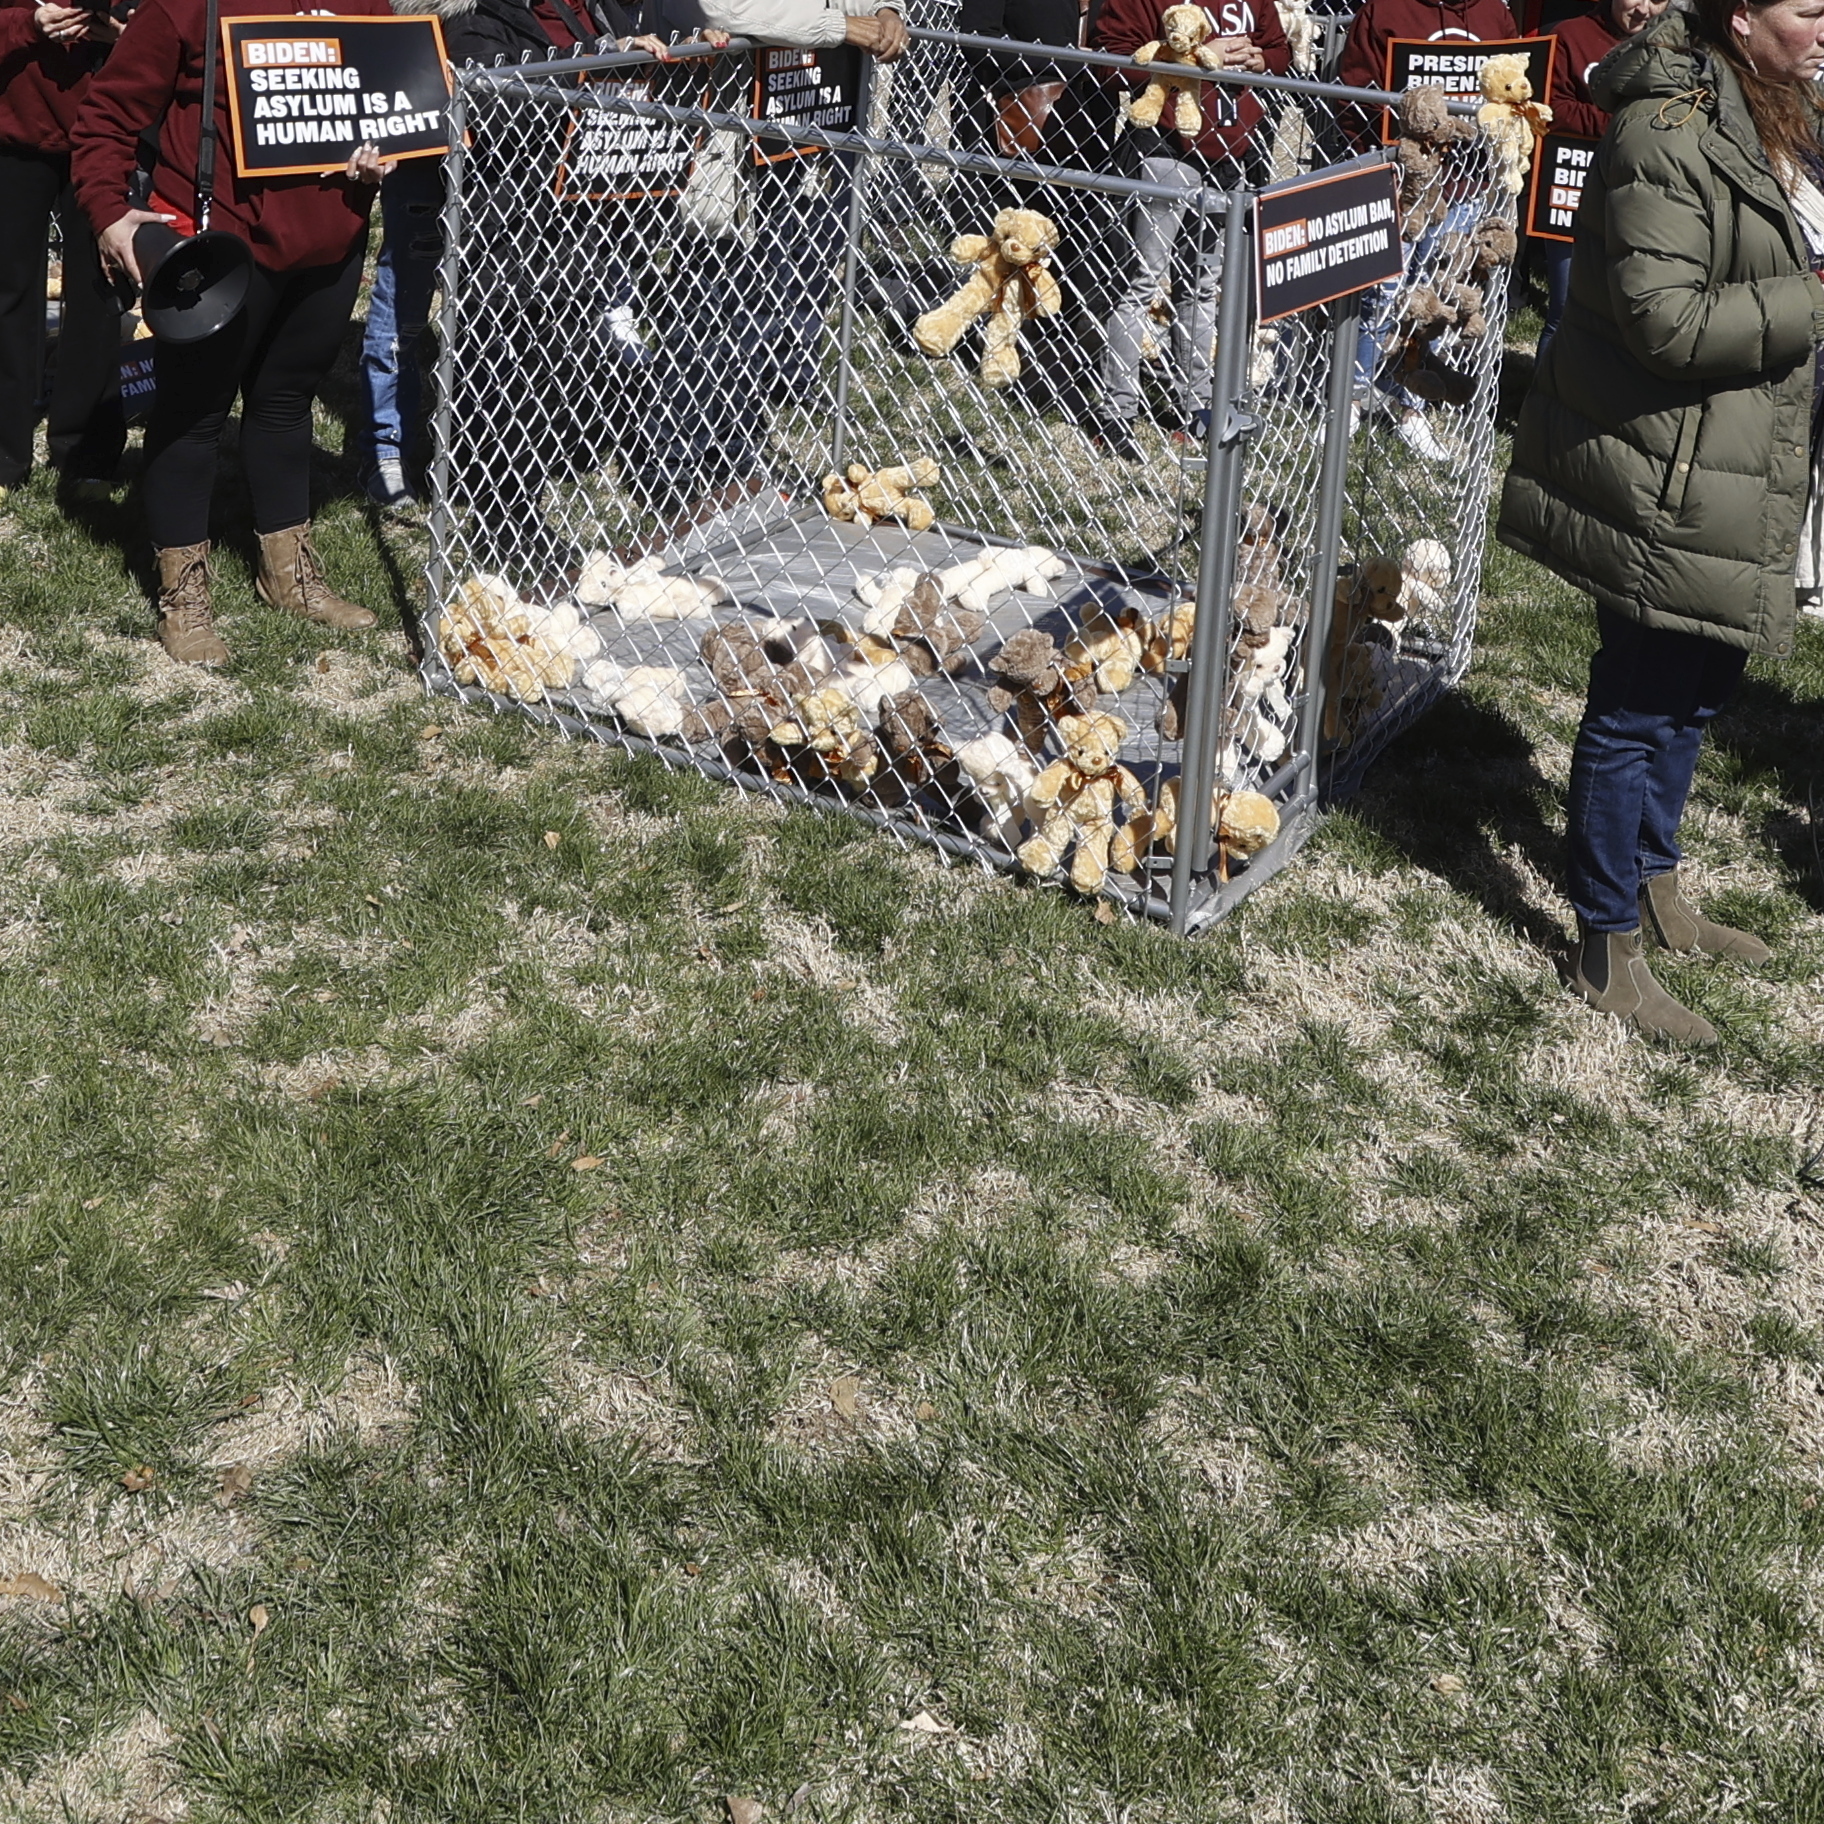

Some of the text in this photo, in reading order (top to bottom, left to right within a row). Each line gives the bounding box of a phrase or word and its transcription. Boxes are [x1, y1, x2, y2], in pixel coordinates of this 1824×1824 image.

[248, 42, 336, 64] BIDEN:
[769, 48, 813, 69] BIDEN:
[250, 67, 360, 91] SEEKING
[768, 67, 821, 92] SEEKING
[254, 91, 412, 118] ASYLUM IS A
[766, 87, 841, 116] ASYLUM IS A
[256, 110, 440, 145] HUMAN RIGHT
[1265, 198, 1395, 256] BIDEN: NO ASYLUM BAN,
[1549, 208, 1573, 227] IN
[1266, 228, 1389, 288] NO FAMILY DETENTION
